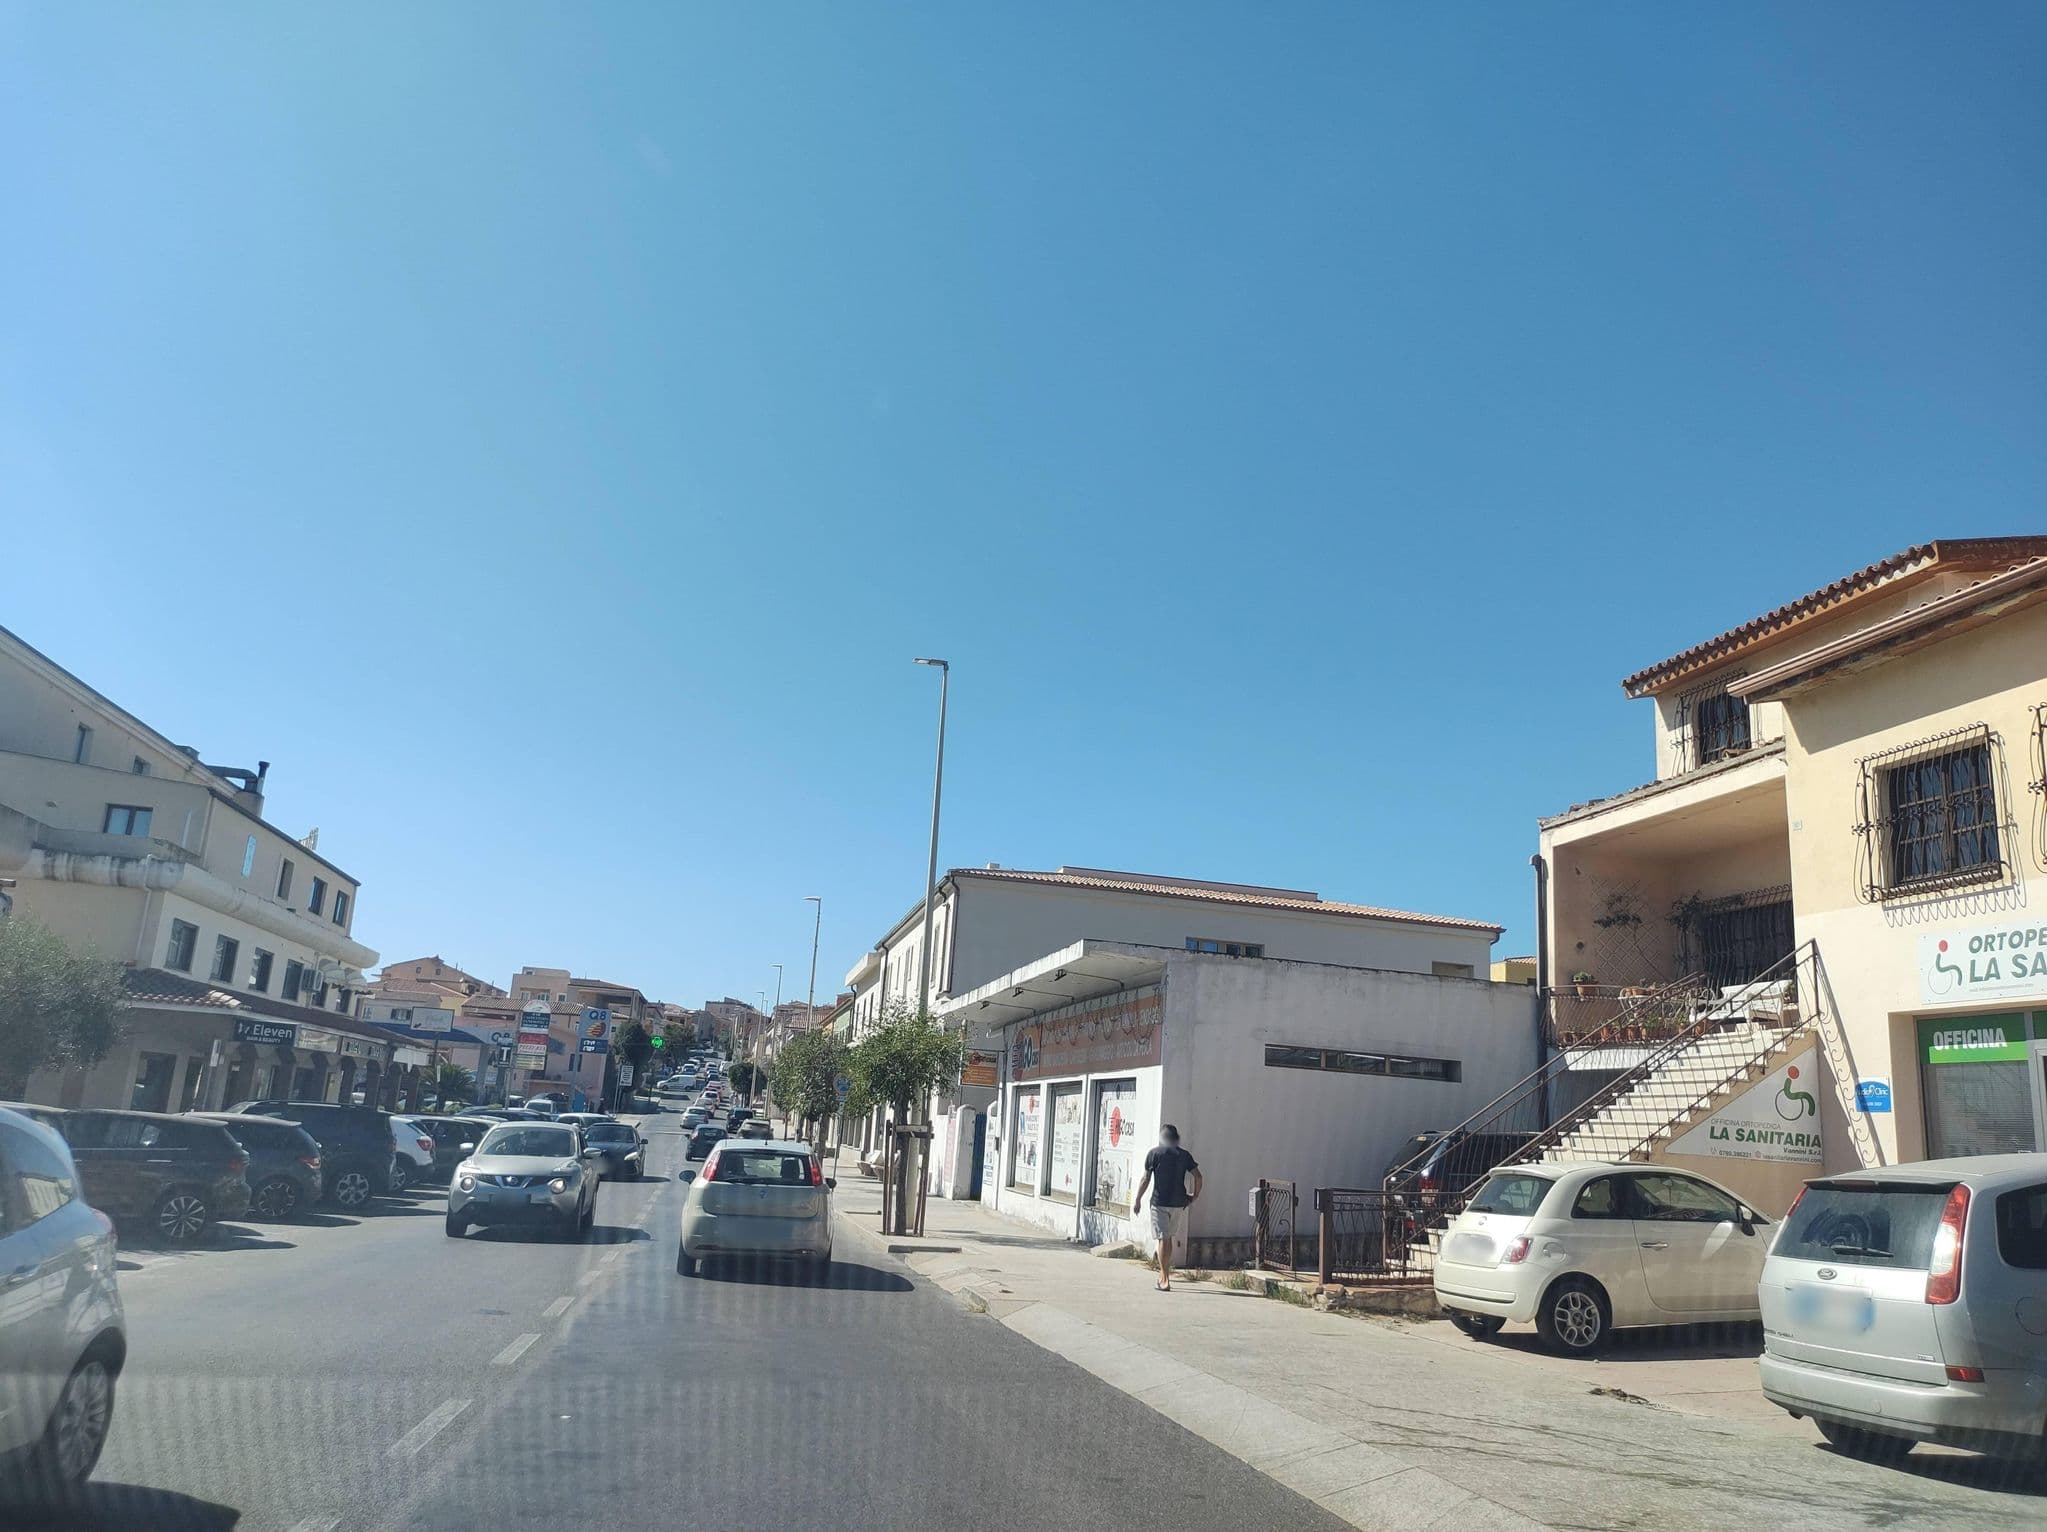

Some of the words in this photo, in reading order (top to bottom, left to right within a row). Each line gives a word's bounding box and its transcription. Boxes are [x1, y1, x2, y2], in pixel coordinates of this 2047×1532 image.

[1968, 926, 2047, 954] ORTOPE
[1969, 957, 2001, 983] LA
[2011, 951, 2047, 979] SA
[589, 1010, 607, 1021] Q8
[253, 1024, 292, 1038] Eleven
[1933, 1027, 2008, 1051] OFFICINA
[1710, 1118, 1740, 1127] OFFICINA
[1740, 1121, 1782, 1130] ORTOPEDICA
[1709, 1125, 1730, 1141] LA
[1735, 1128, 1822, 1148] SANITARIA
[1783, 1147, 1807, 1155] Vannini
